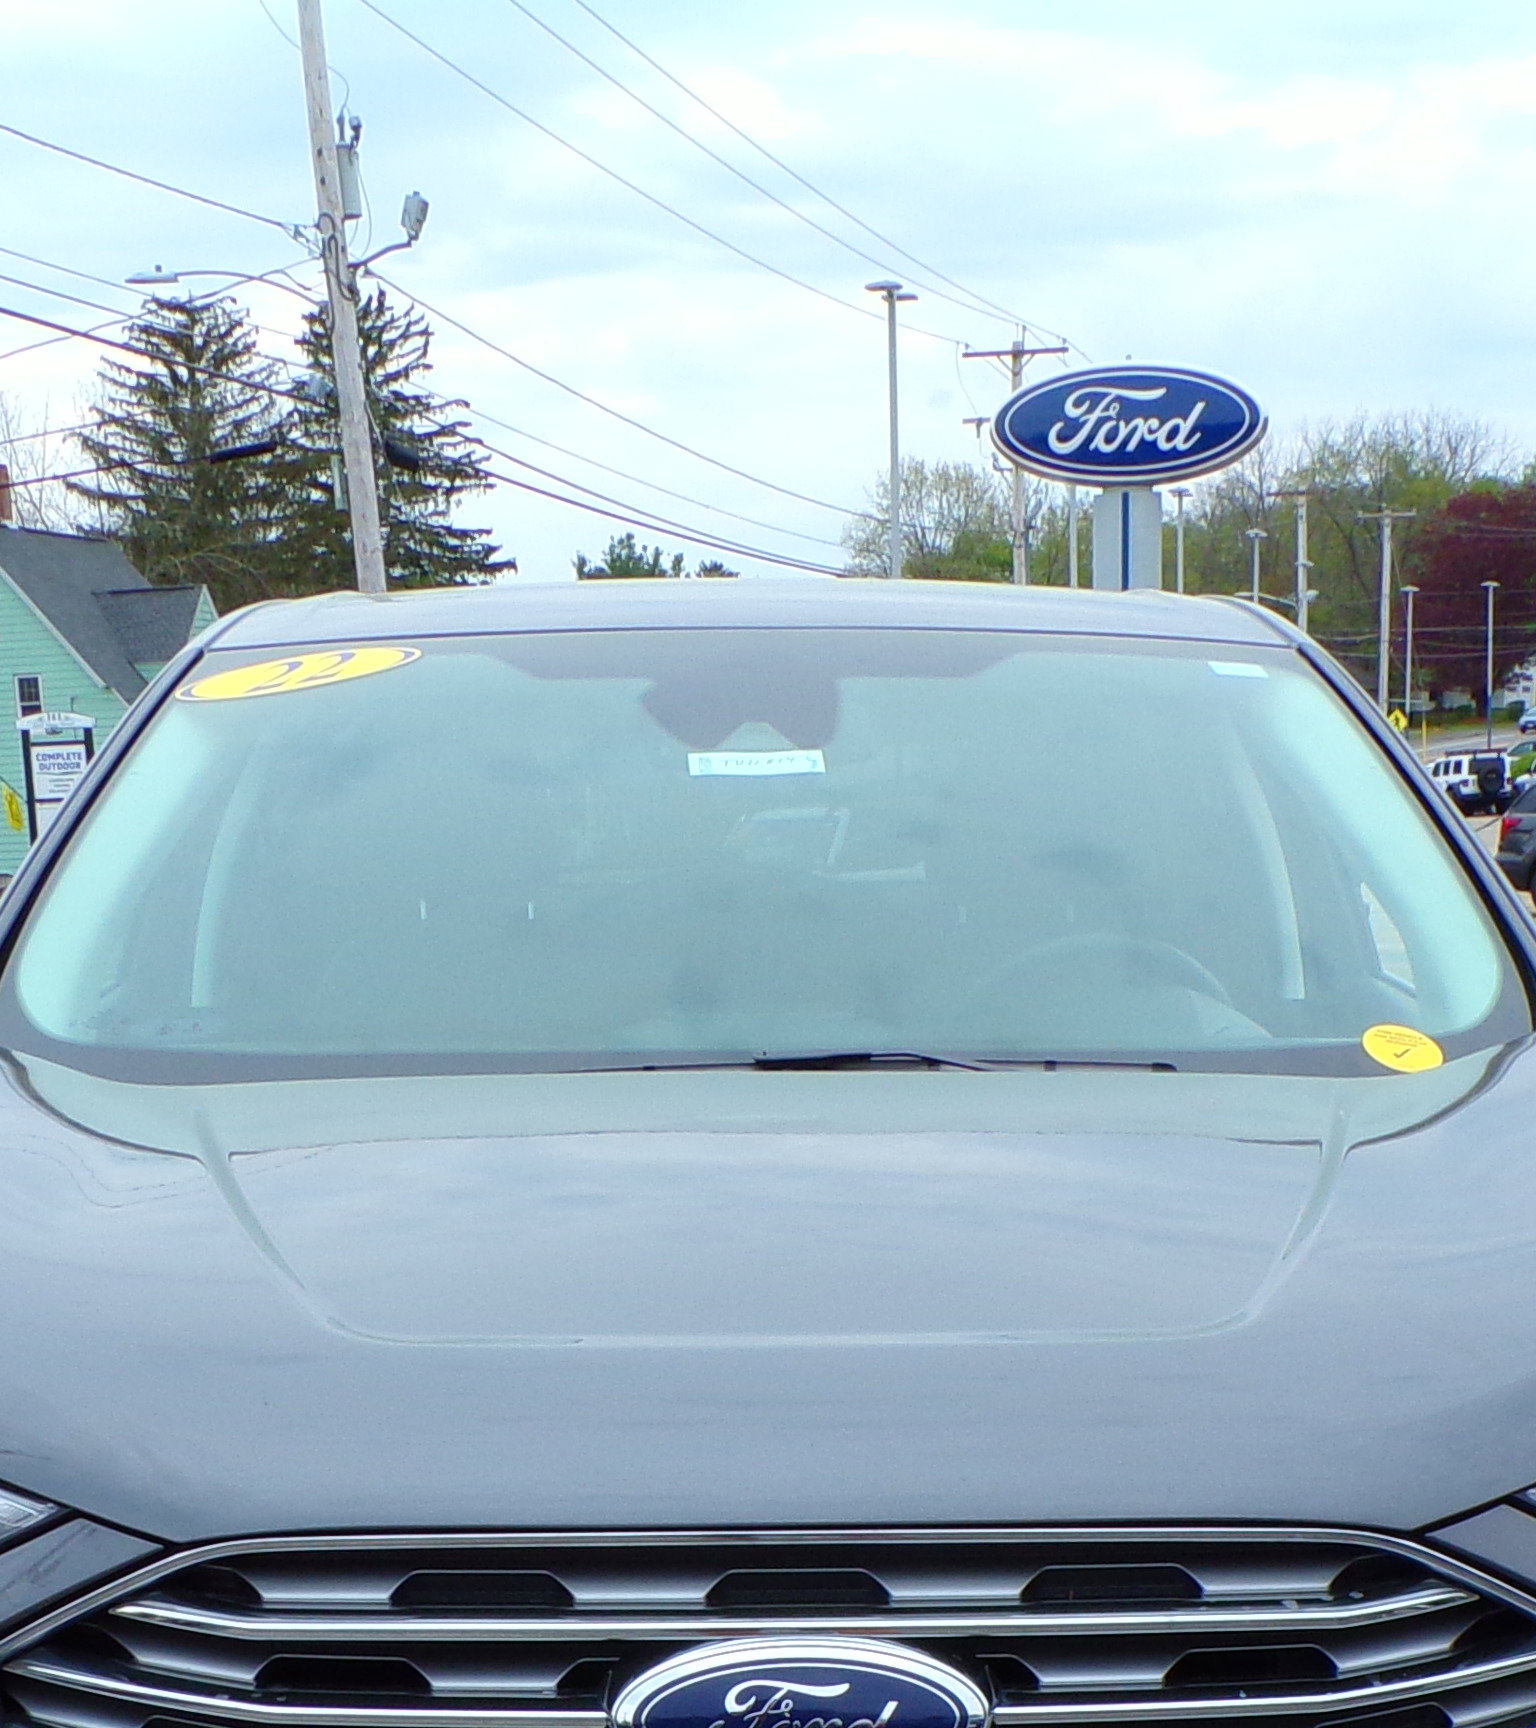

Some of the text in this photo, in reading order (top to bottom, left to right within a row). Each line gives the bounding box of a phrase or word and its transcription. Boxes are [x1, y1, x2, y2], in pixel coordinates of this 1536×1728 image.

[1048, 386, 1206, 455] Ford
[240, 651, 357, 694] 22
[35, 751, 83, 762] COMPLETE
[38, 761, 81, 771] OUTDOOR
